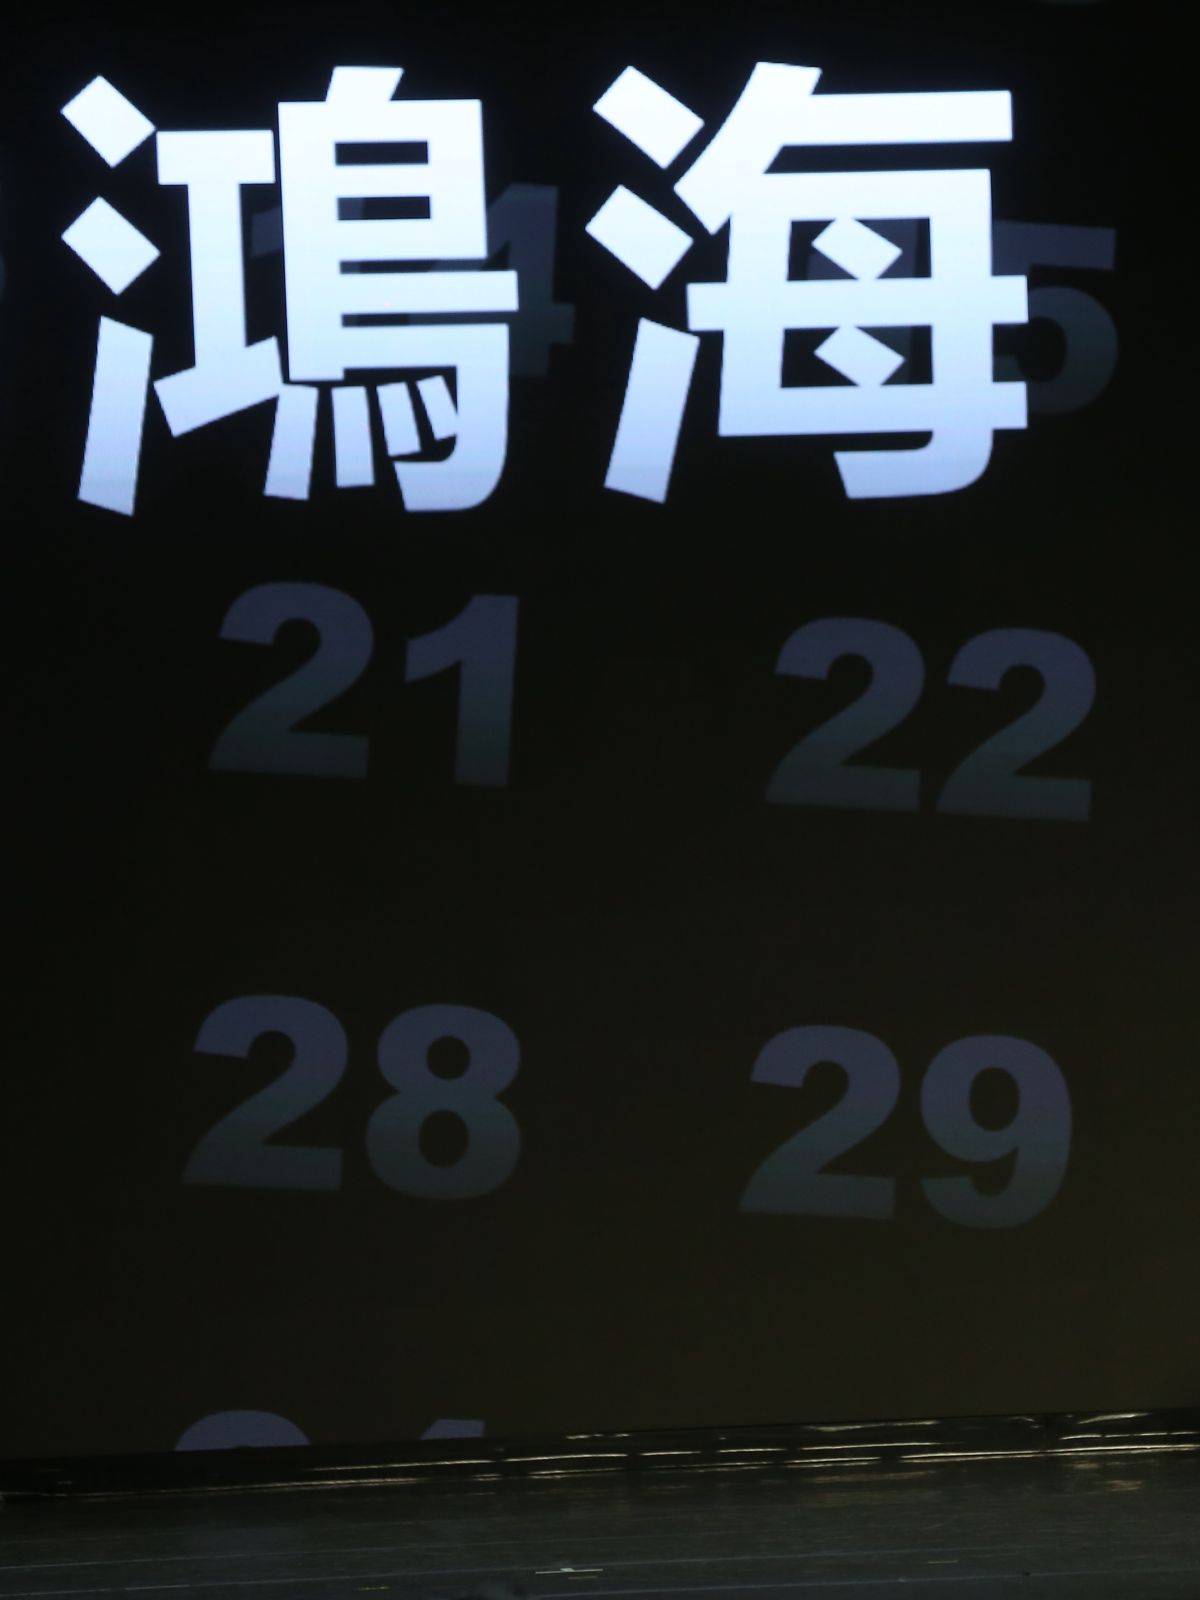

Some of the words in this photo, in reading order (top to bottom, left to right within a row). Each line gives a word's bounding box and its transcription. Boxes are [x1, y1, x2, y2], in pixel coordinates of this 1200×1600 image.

[60, 61, 1028, 516] 鴻海
[207, 581, 520, 787] 21
[764, 616, 1097, 821] 22
[181, 994, 522, 1199] 28
[739, 1024, 1072, 1228] 29
